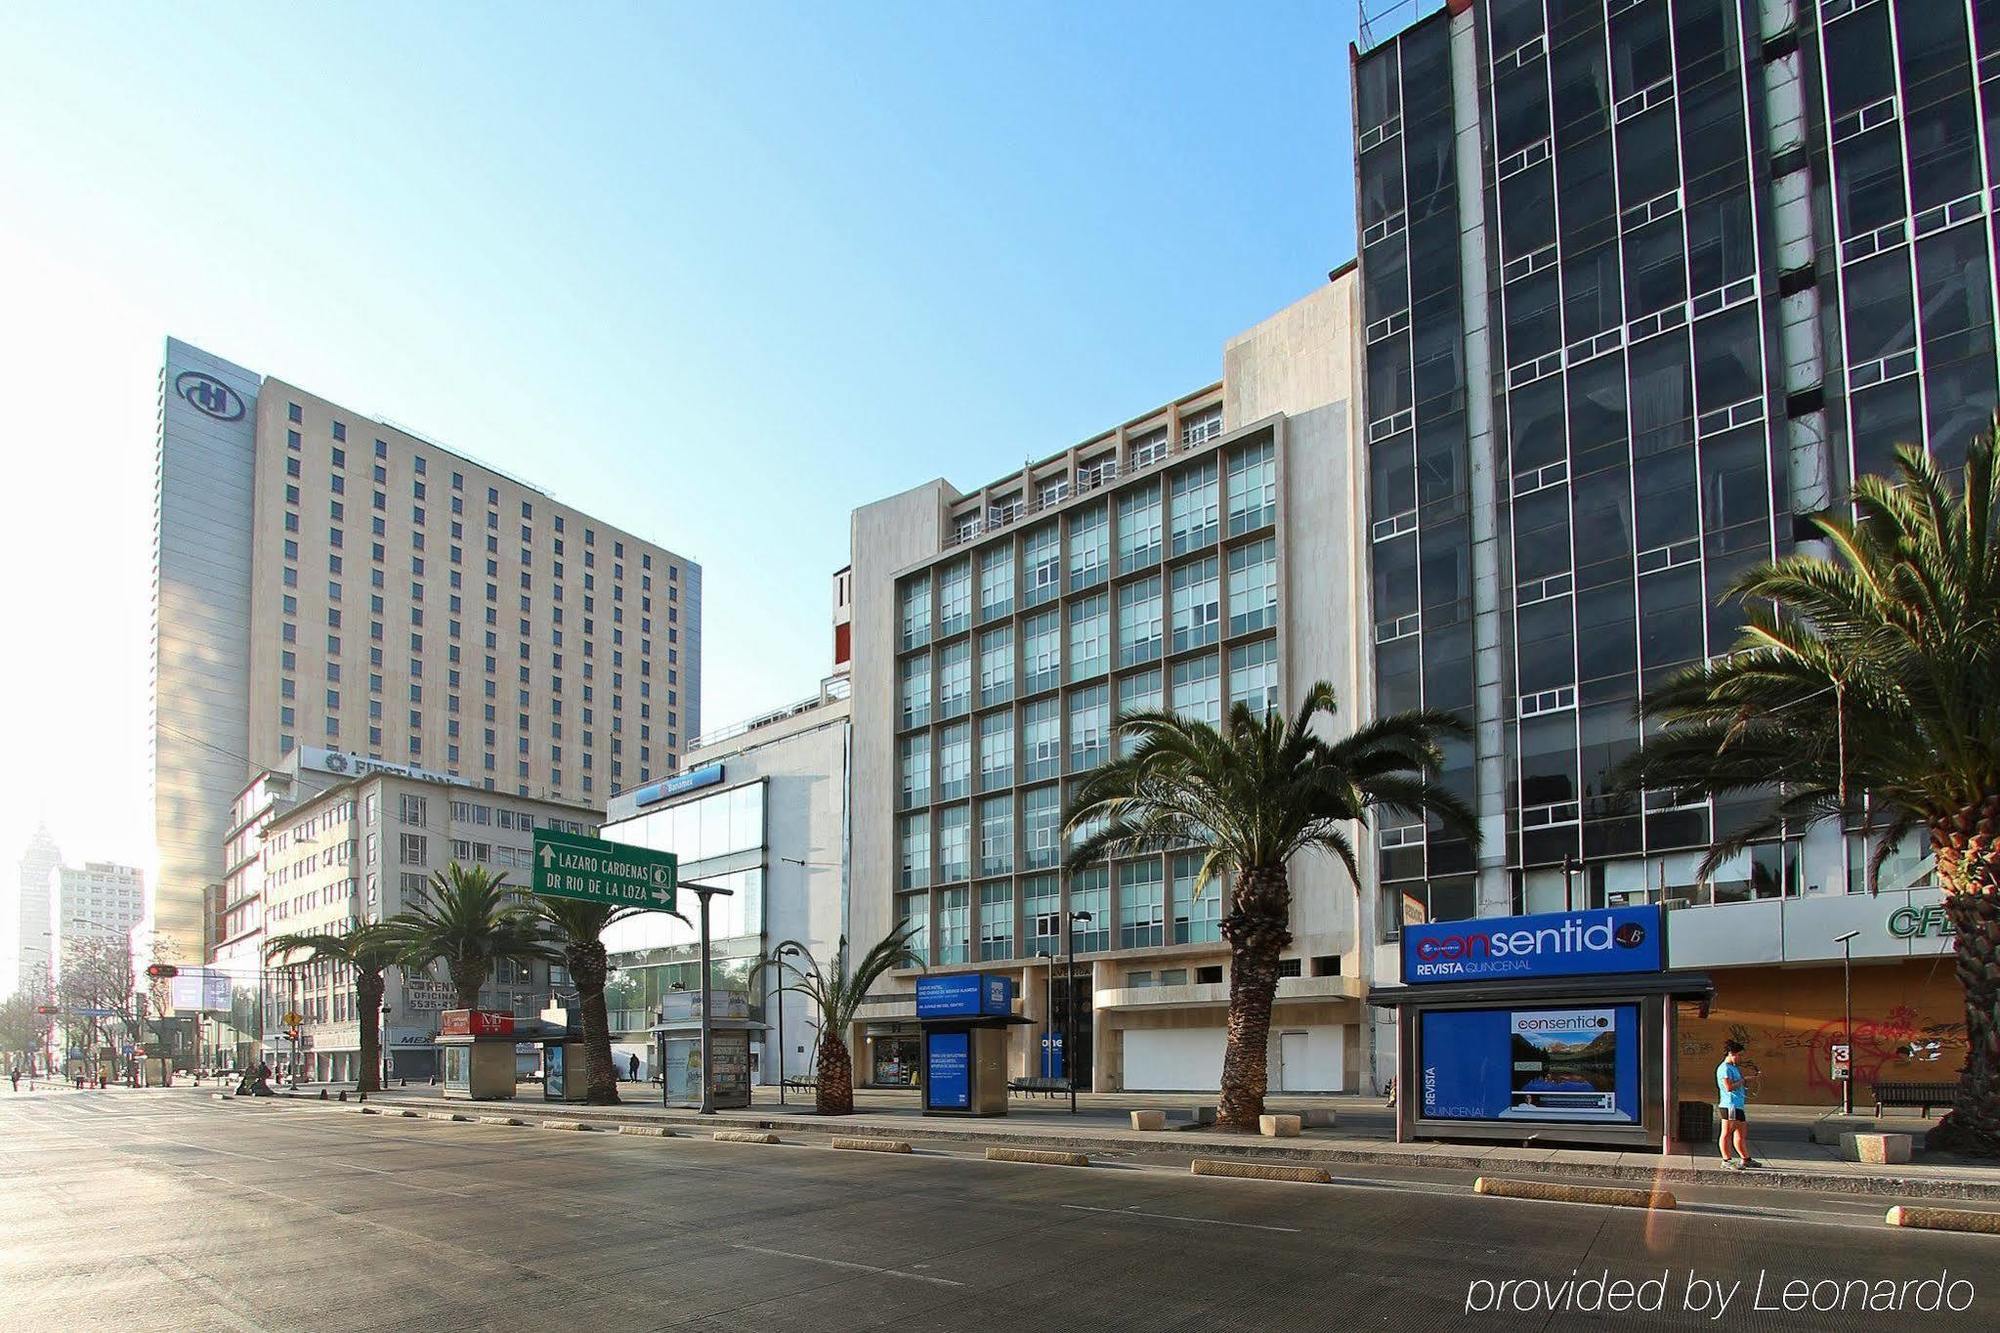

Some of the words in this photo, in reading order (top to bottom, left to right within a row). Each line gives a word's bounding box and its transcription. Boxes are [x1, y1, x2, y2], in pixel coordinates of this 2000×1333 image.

[559, 852, 598, 873] LAZARO
[601, 860, 648, 881] CARDENAS
[546, 872, 561, 889] DR
[566, 875, 583, 892] RIO
[588, 879, 601, 894] DE
[606, 881, 618, 897] LA
[623, 884, 648, 900] LOZA
[1417, 962, 1464, 976] REVISTA
[1465, 959, 1531, 973] QUINCENAL
[1425, 1067, 1436, 1105] REVISTA
